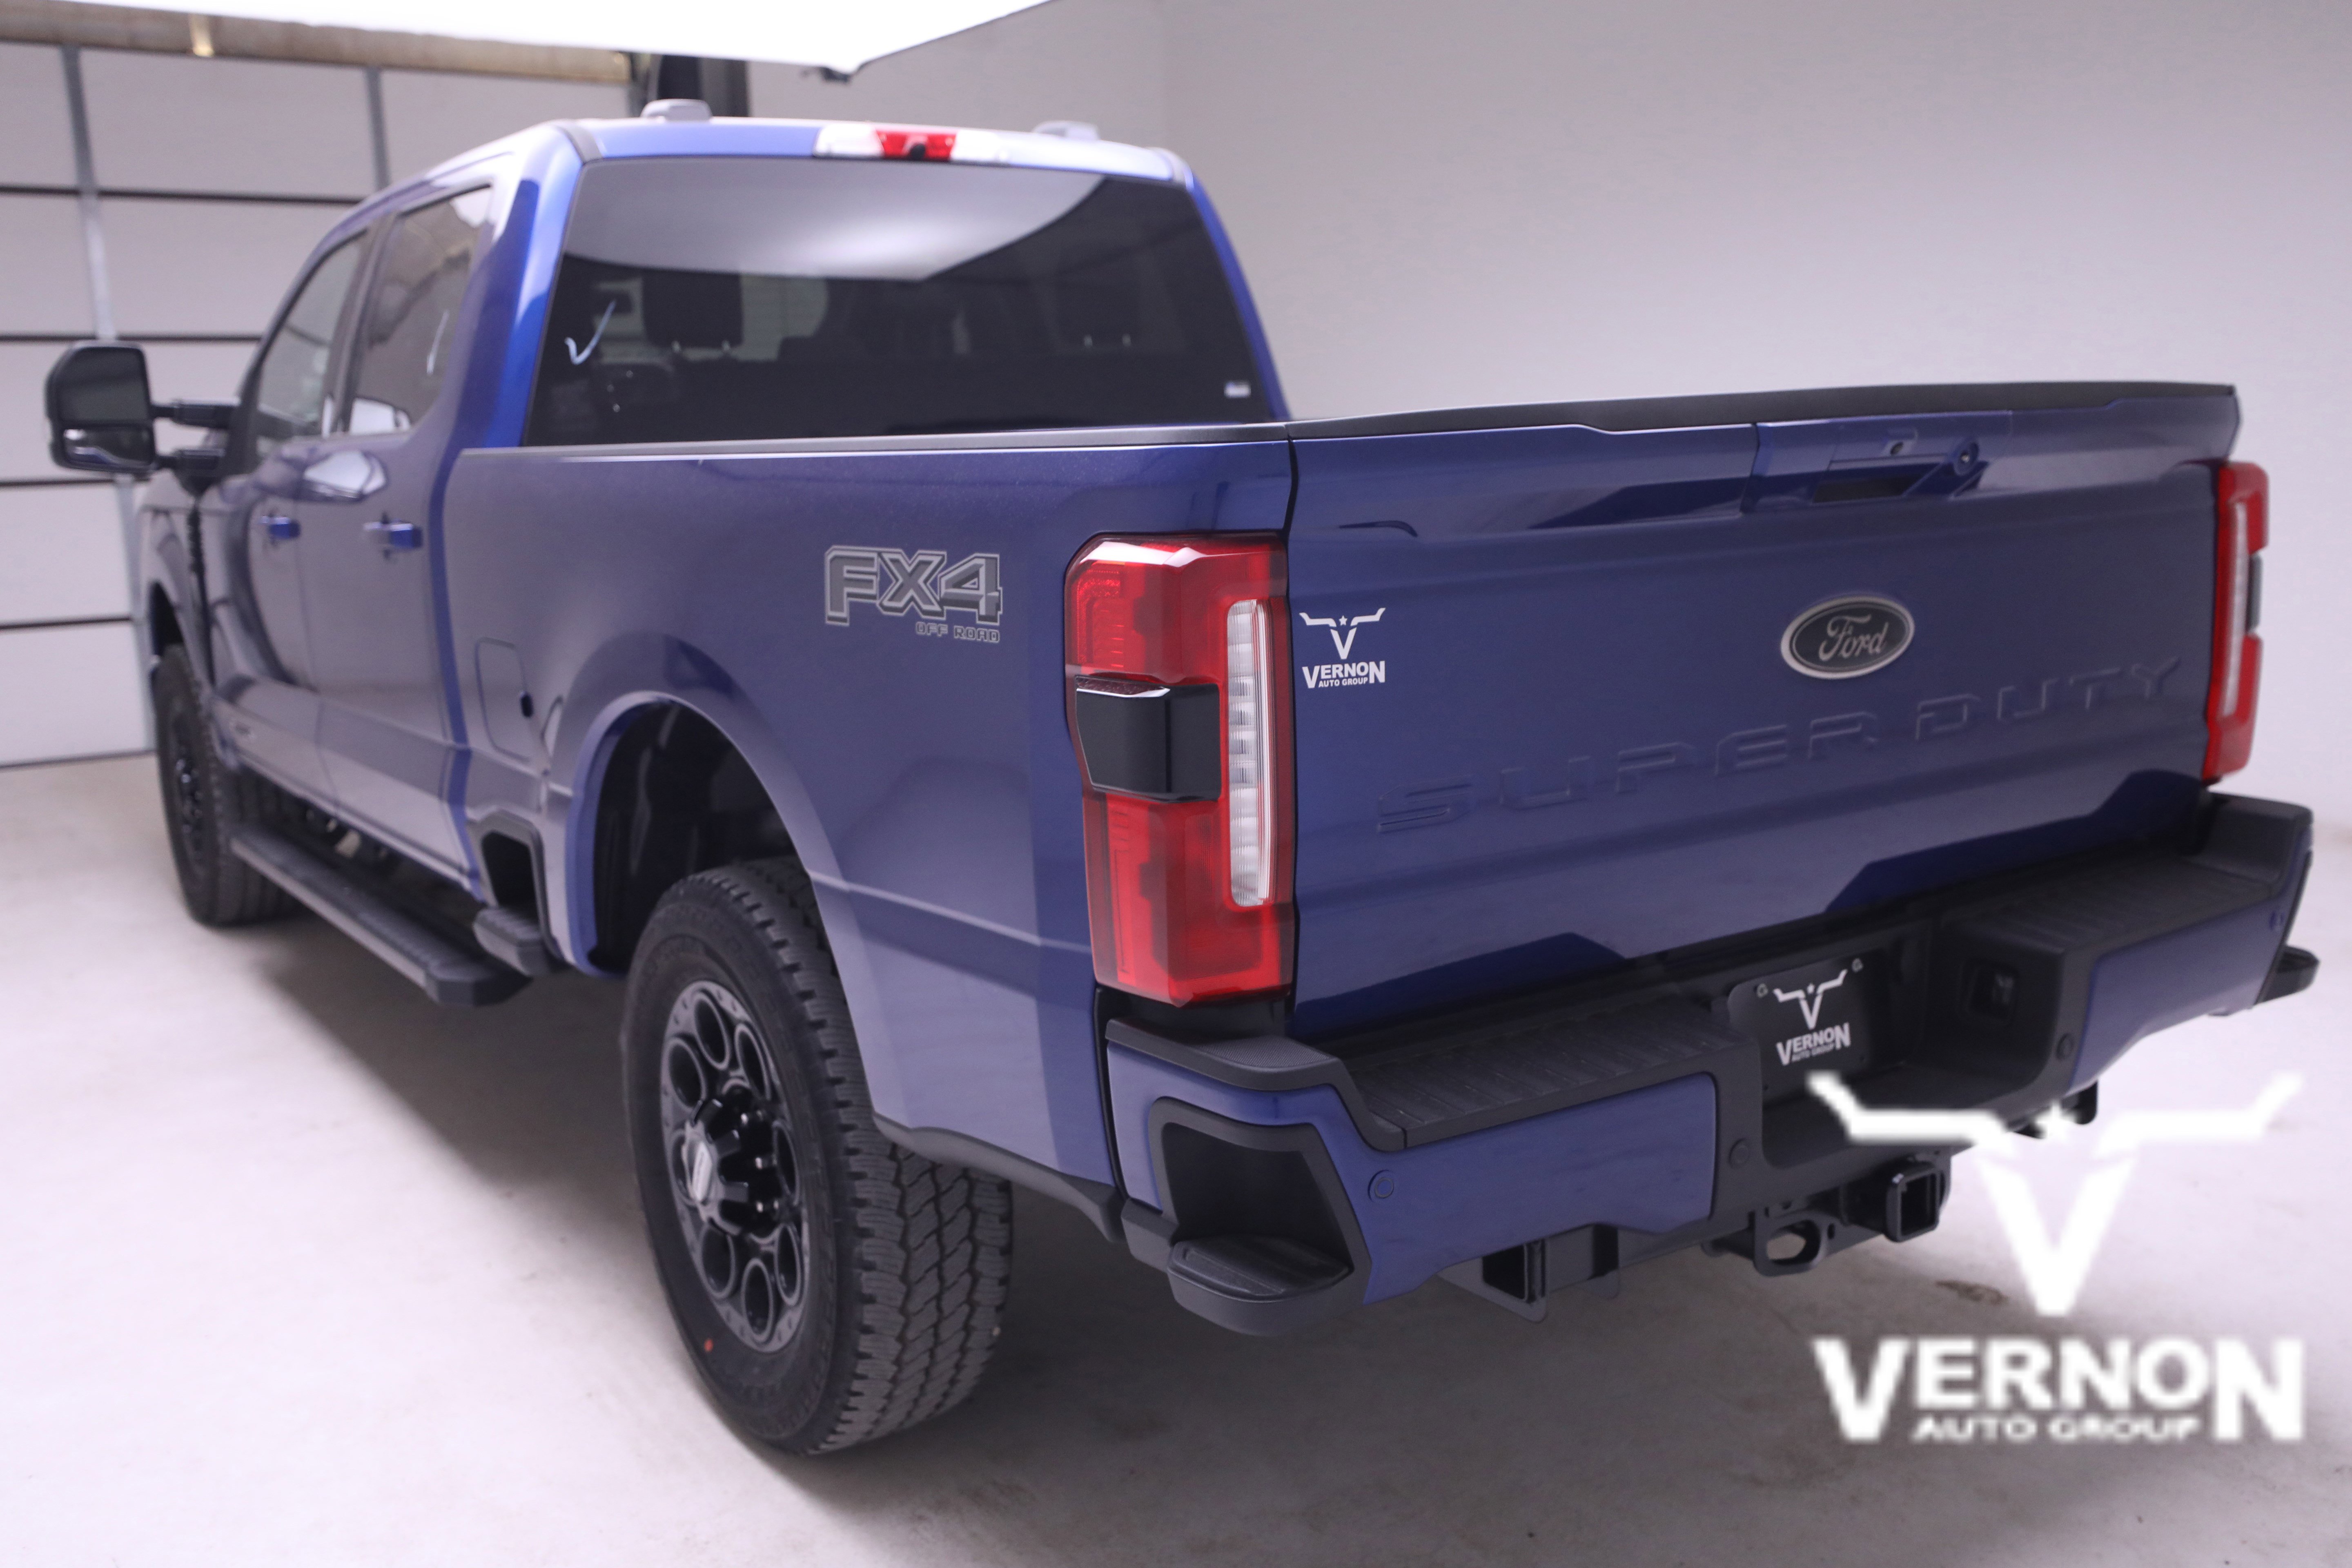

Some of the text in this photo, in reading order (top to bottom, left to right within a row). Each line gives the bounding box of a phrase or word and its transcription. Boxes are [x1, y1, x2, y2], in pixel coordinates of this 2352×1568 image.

[824, 545, 1003, 626] FX4
[915, 622, 1000, 643] OFF ROAD
[1818, 614, 1889, 662] Ford
[1302, 661, 1385, 688] VERNON
[1319, 677, 1368, 688] AUTO GROUP
[1376, 656, 2181, 833] SUPER DUTY
[1776, 1022, 1851, 1065] VERNON
